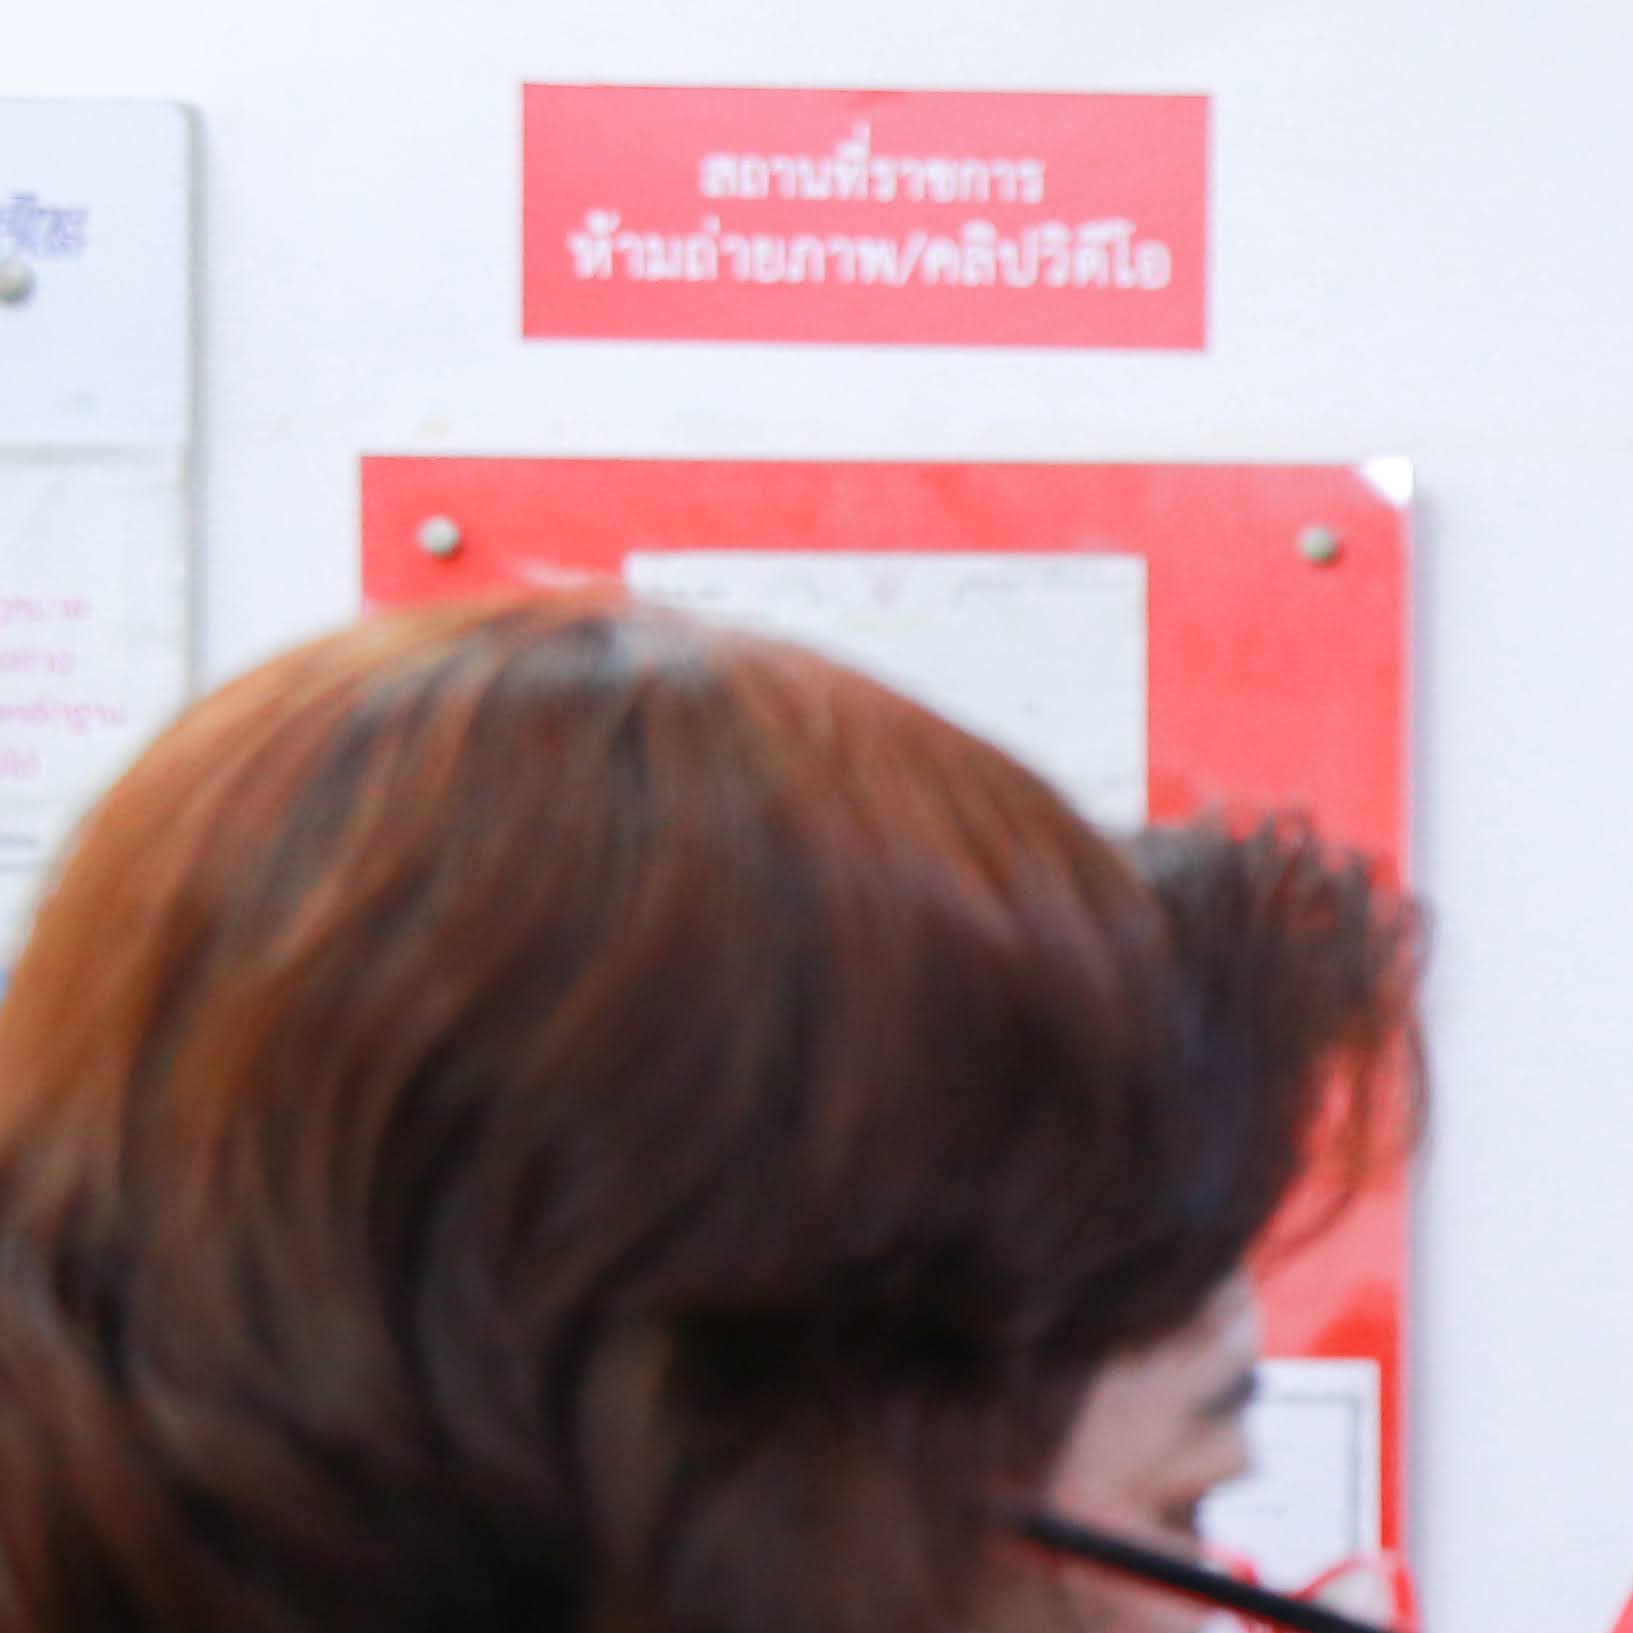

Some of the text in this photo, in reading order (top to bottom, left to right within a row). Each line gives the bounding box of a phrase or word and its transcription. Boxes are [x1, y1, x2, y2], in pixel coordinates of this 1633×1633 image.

[702, 120, 1046, 204] สถานที่ราชการ
